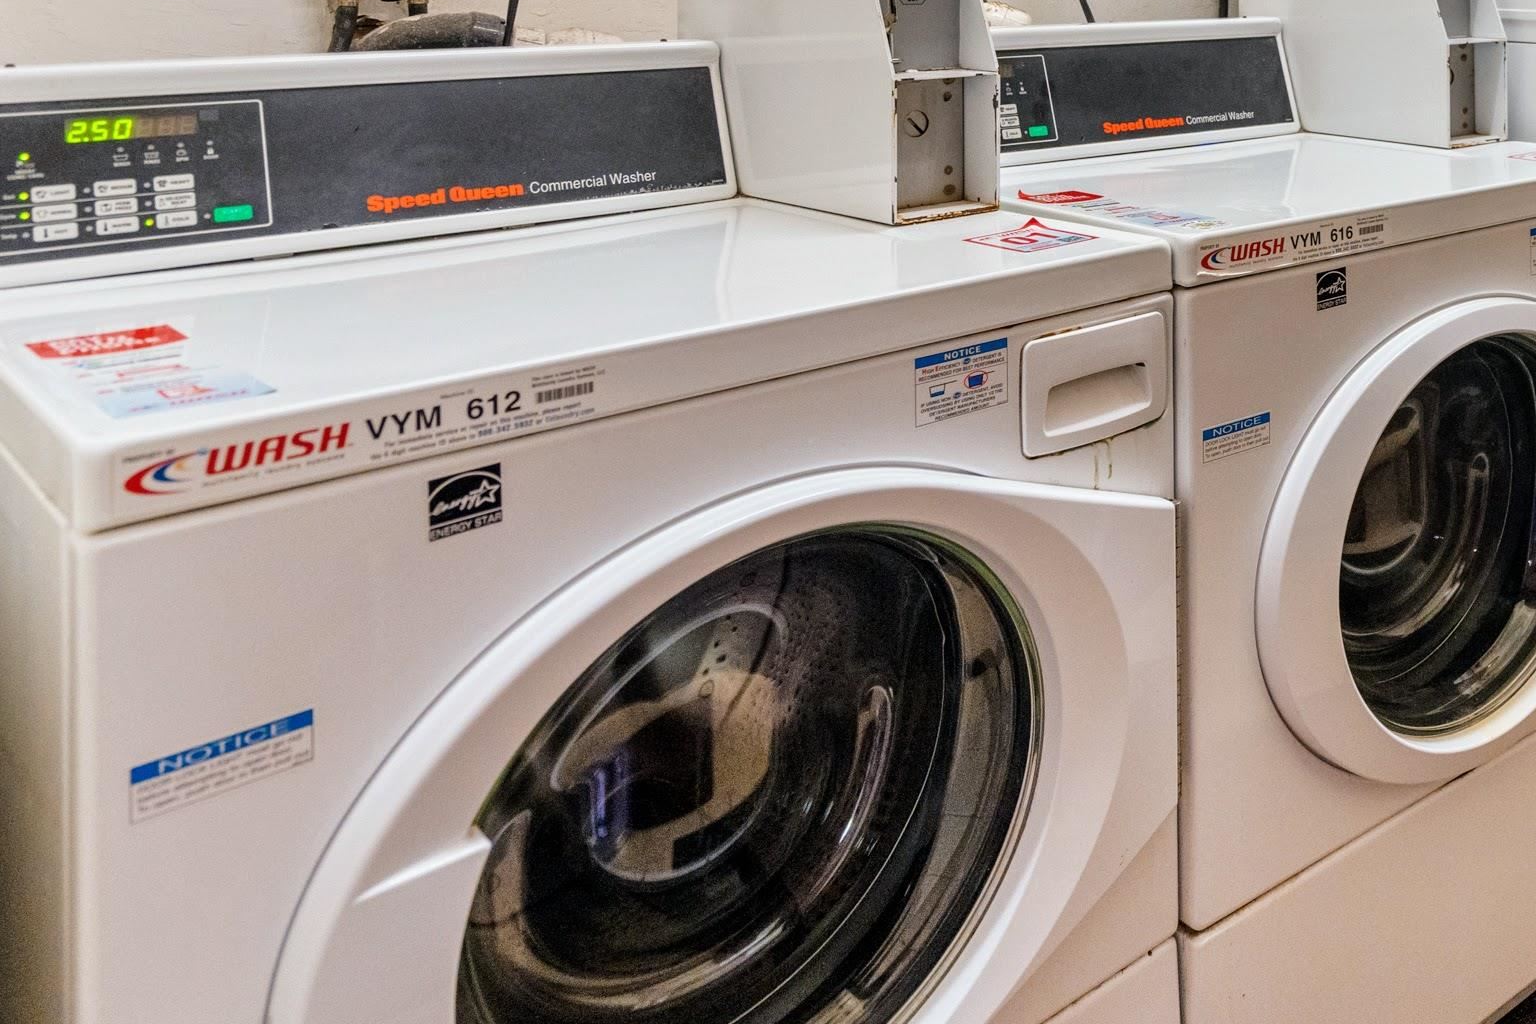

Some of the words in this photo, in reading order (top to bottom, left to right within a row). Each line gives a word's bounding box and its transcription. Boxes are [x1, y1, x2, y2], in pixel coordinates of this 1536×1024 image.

[66, 119, 133, 143] 2.50
[1103, 118, 1144, 135] Speed
[1145, 116, 1184, 129] Queen
[1185, 113, 1228, 126] Commercial
[1229, 110, 1255, 121] Washer
[366, 188, 446, 213] Speed
[449, 182, 525, 205] Queen
[529, 174, 607, 194] Commercial
[609, 170, 657, 185] Washer
[1230, 237, 1285, 262] WASH
[1290, 231, 1321, 249] VYM
[1330, 226, 1353, 242] 616
[1317, 300, 1334, 311] ENERGY
[944, 345, 981, 361] NOTICE
[972, 354, 998, 363] DETERGENT
[918, 371, 952, 382] RECOMMENDED
[974, 357, 1005, 368] PERFORMANCE
[205, 422, 351, 476] WASH
[366, 405, 442, 440] VYM
[467, 390, 521, 420] 612
[1213, 416, 1261, 437] NOTICE
[430, 520, 471, 541] ENERGY
[474, 510, 502, 529] STAR
[158, 720, 289, 776] NOTICE
